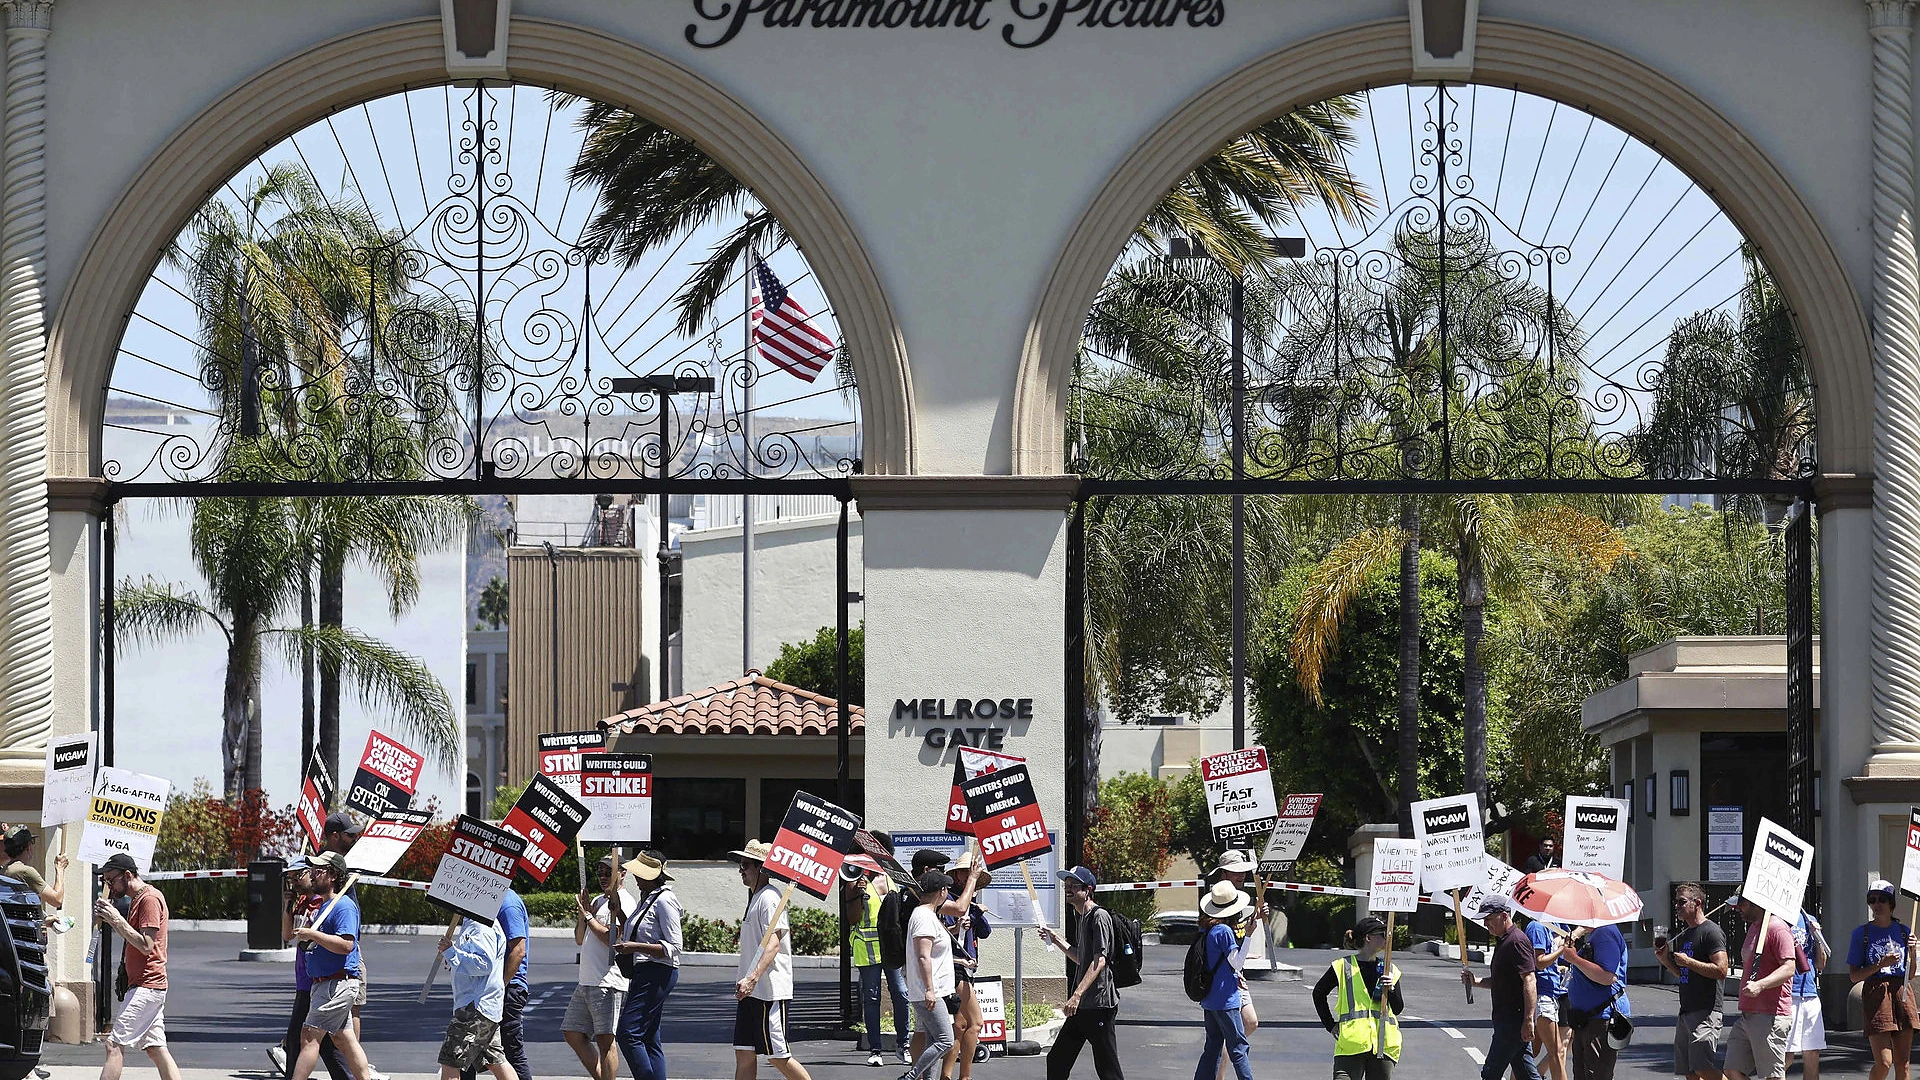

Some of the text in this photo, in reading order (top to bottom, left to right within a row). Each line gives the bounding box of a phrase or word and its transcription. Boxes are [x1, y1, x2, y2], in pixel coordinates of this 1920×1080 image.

[685, 0, 1226, 49] Paramount Pictures
[896, 698, 1034, 720] MELROSE
[542, 734, 602, 748] WRITERS GUILD
[925, 727, 1004, 749] GATE
[56, 749, 87, 763] WGAW
[372, 736, 418, 769] WRITERS
[1206, 749, 1259, 766] WRITERS
[370, 748, 414, 777] GUILD OF
[544, 752, 582, 773] STRI
[586, 759, 647, 770] WRITERS GUILD
[1208, 763, 1263, 778] AMERICA
[1209, 756, 1258, 772] GUILD OF
[364, 756, 413, 790] AMERICA
[375, 782, 391, 798] ON
[585, 776, 647, 795] STRIKE!
[965, 772, 1025, 798] WRITERS GUILD
[1208, 781, 1228, 792] THE
[351, 785, 401, 815] STRI
[534, 780, 565, 809] WRITERS
[562, 804, 583, 824] GUILD
[994, 790, 1004, 799] OF
[1221, 787, 1254, 803] FAST
[95, 799, 158, 825] UNIONS
[548, 806, 558, 816] OF
[985, 796, 1021, 814] AMERICA
[1213, 801, 1258, 815] FURIOUS
[92, 814, 155, 833] STAND TOGETHER
[381, 811, 428, 824] WRITERS GUILD
[530, 806, 562, 835] AMERICA
[796, 799, 855, 831] WRITERS GUILD
[1001, 815, 1017, 829] ON
[1426, 812, 1467, 827] WGAW
[1577, 812, 1616, 824] WGAW
[368, 823, 419, 842] STRIKE!
[815, 819, 825, 829] OF
[1219, 818, 1275, 839] STRIKE
[461, 821, 521, 852] WRITERS GUILD
[529, 827, 545, 844] ON
[797, 822, 834, 846] AMERICA
[981, 820, 1045, 856] STRIKE!
[1427, 832, 1481, 847] WASN'T MEANT
[105, 838, 130, 851] WGA
[483, 840, 493, 849] ON
[503, 824, 555, 874] IKE!
[801, 842, 818, 859] ON
[1376, 840, 1418, 857] WHEN THE
[1435, 849, 1447, 857] GET
[1453, 846, 1470, 854] THIS
[1768, 837, 1802, 864] WGAW
[451, 837, 515, 876] STRIKE!
[770, 847, 836, 887] STRIKE!
[1258, 862, 1292, 872] STRIKE
[1382, 859, 1414, 872] LIGHT
[1425, 863, 1443, 872] MUCH
[1467, 865, 1498, 911] PAY US
[1491, 866, 1513, 894] SPOCK
[1375, 885, 1410, 896] YOU CAN
[1374, 897, 1412, 907] TURN IN
